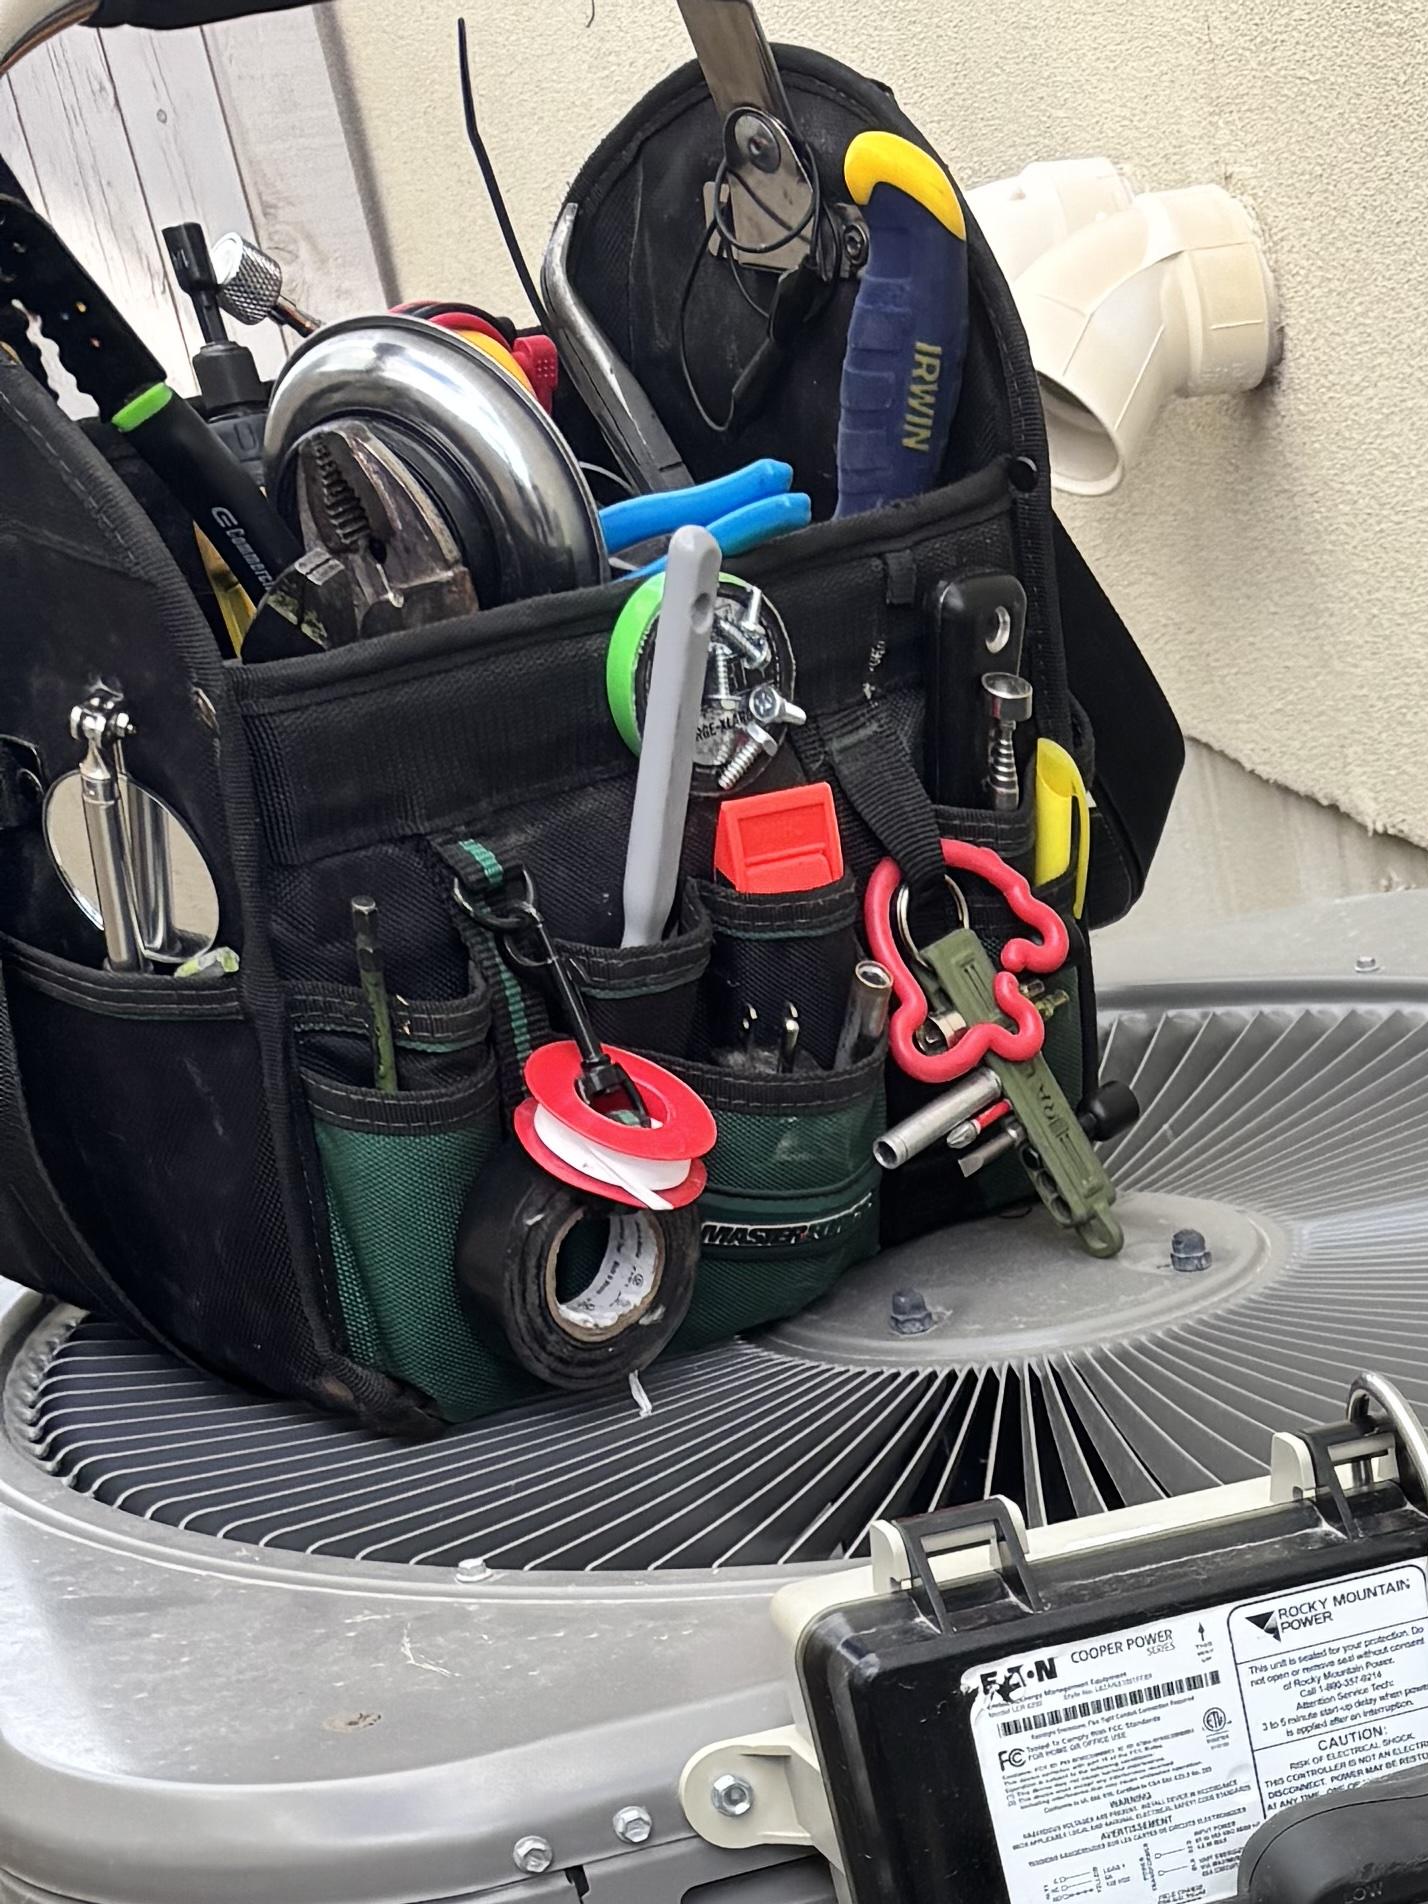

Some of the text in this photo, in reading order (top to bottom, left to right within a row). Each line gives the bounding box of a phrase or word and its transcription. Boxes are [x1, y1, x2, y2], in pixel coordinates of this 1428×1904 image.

[902, 341, 942, 451] IRWIN
[1278, 1578, 1411, 1620] ROCKY MOUNTAIN
[1280, 1612, 1334, 1633] POWER
[1071, 1629, 1173, 1664] COOPER POWER
[1342, 1641, 1362, 1655] your
[1411, 1626, 1425, 1635] Do
[1267, 1672, 1290, 1686] open
[1294, 1658, 1395, 1688] Rocky Mountain Power.
[1296, 1688, 1364, 1710] Attention Service
[1299, 1687, 1317, 1698] Call
[1354, 1696, 1378, 1710] delay
[1318, 1726, 1388, 1751] CAUTION:
[1289, 1760, 1311, 1770] RISK
[1312, 1756, 1325, 1765] OF
[1327, 1741, 1381, 1761] ELECTRICAL
[1265, 1777, 1284, 1788] THIS
[1286, 1762, 1347, 1783] CONTROLLER
[1358, 1754, 1377, 1765] NOT
[1378, 1749, 1391, 1760] AN
[1330, 1767, 1364, 1783] POWER
[1385, 1758, 1398, 1769] BE
[1279, 1796, 1299, 1808] ANY
